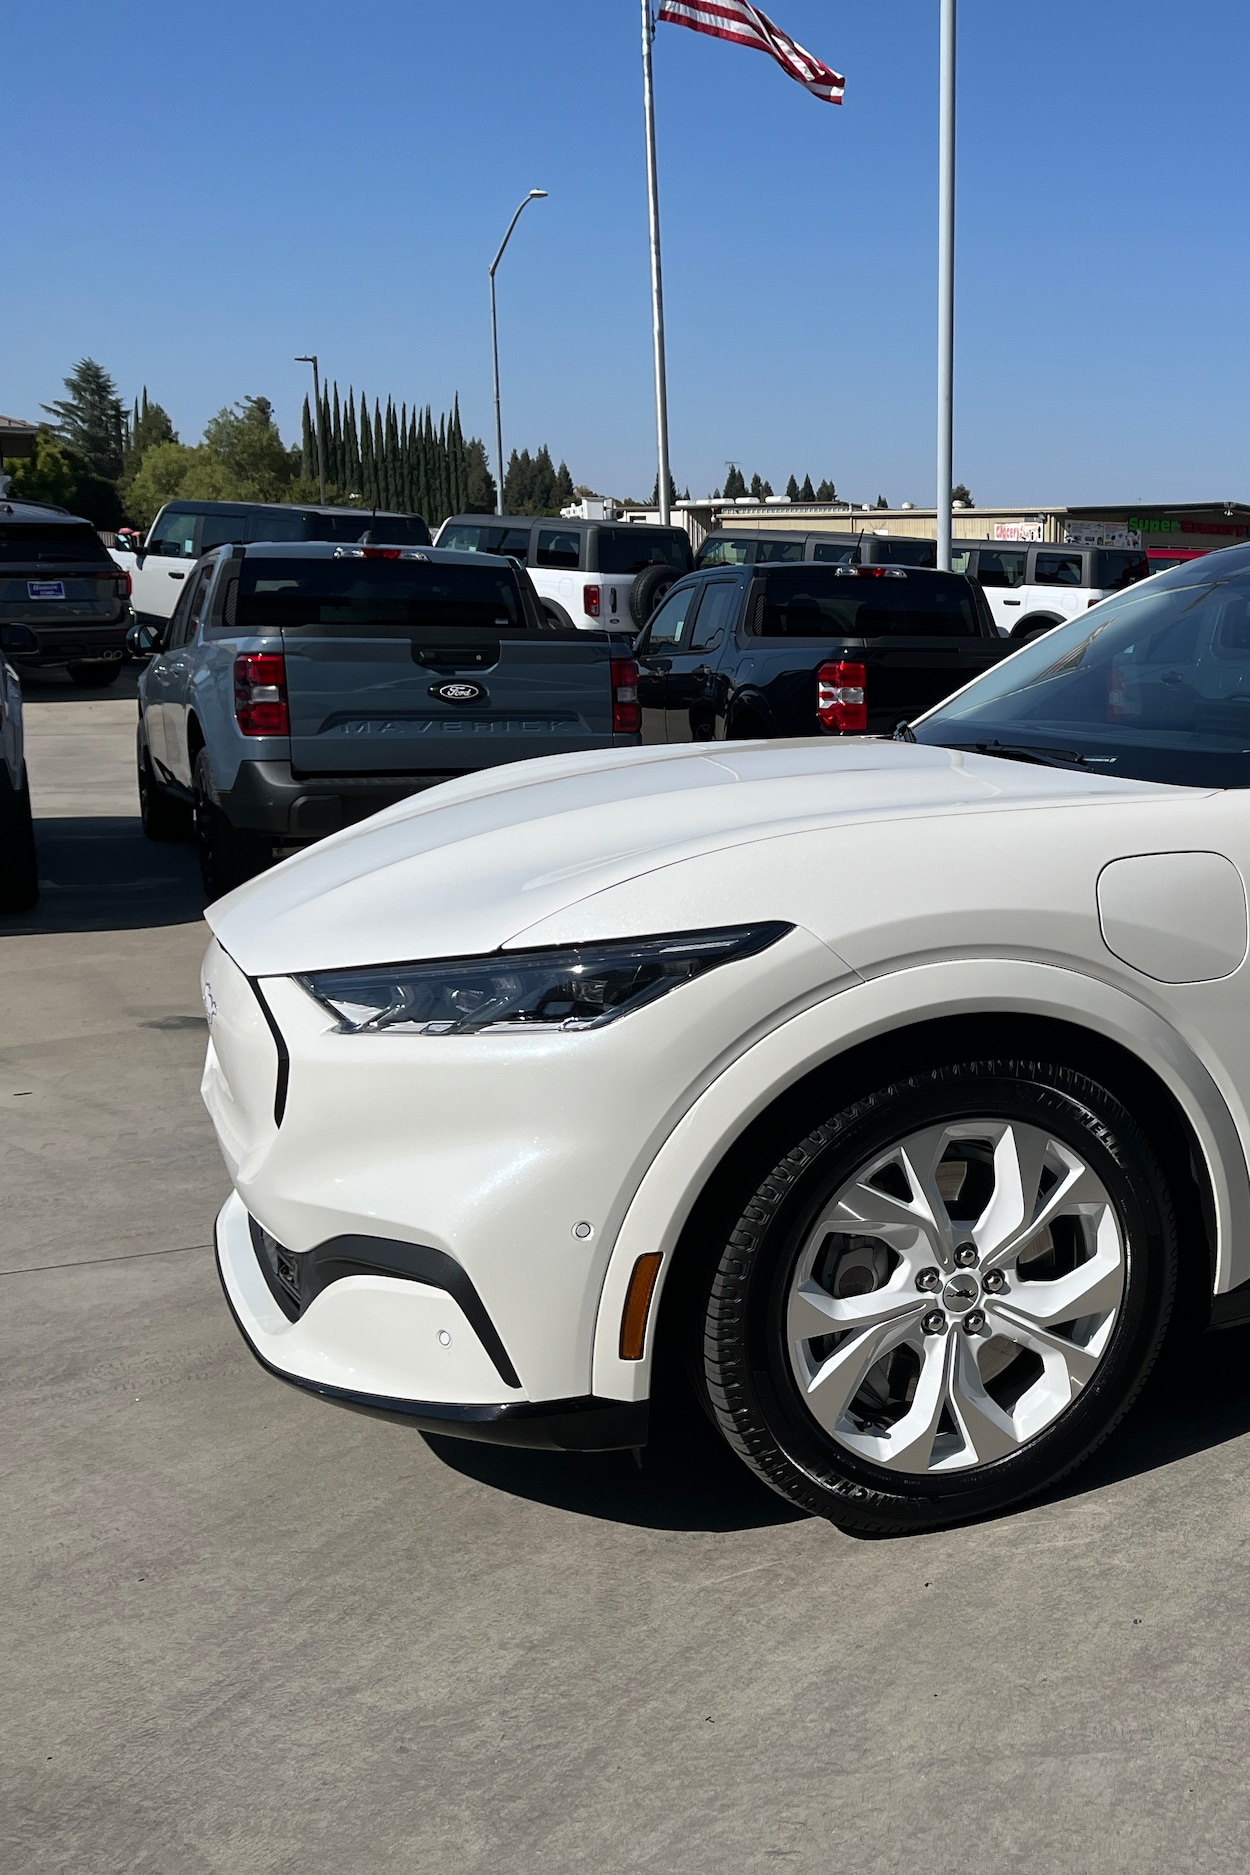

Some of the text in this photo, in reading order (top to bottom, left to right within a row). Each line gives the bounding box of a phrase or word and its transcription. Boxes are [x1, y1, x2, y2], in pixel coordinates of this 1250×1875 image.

[1128, 517, 1179, 533] Super
[1181, 519, 1246, 537] Grocery
[447, 686, 471, 696] Ford
[341, 720, 570, 734] MAVERICK
